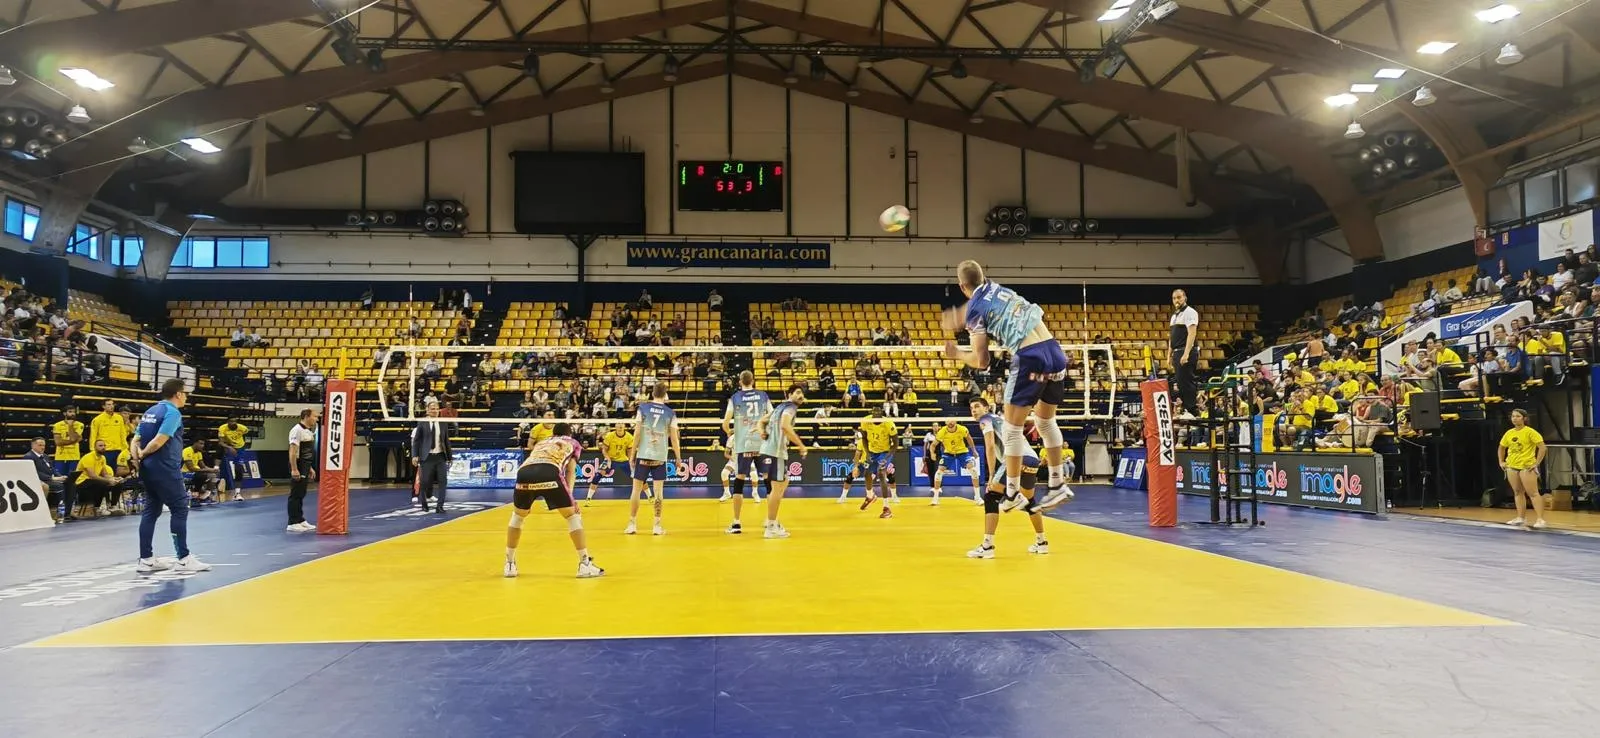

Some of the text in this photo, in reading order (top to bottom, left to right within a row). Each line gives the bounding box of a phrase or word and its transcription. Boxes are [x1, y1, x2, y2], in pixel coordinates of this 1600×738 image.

[629, 243, 827, 263] www.grancanaria.com
[746, 402, 759, 417] 21
[652, 414, 661, 428] 7
[871, 432, 880, 440] 12
[1300, 464, 1362, 504] imagle
[1346, 496, 1362, 505] .com
